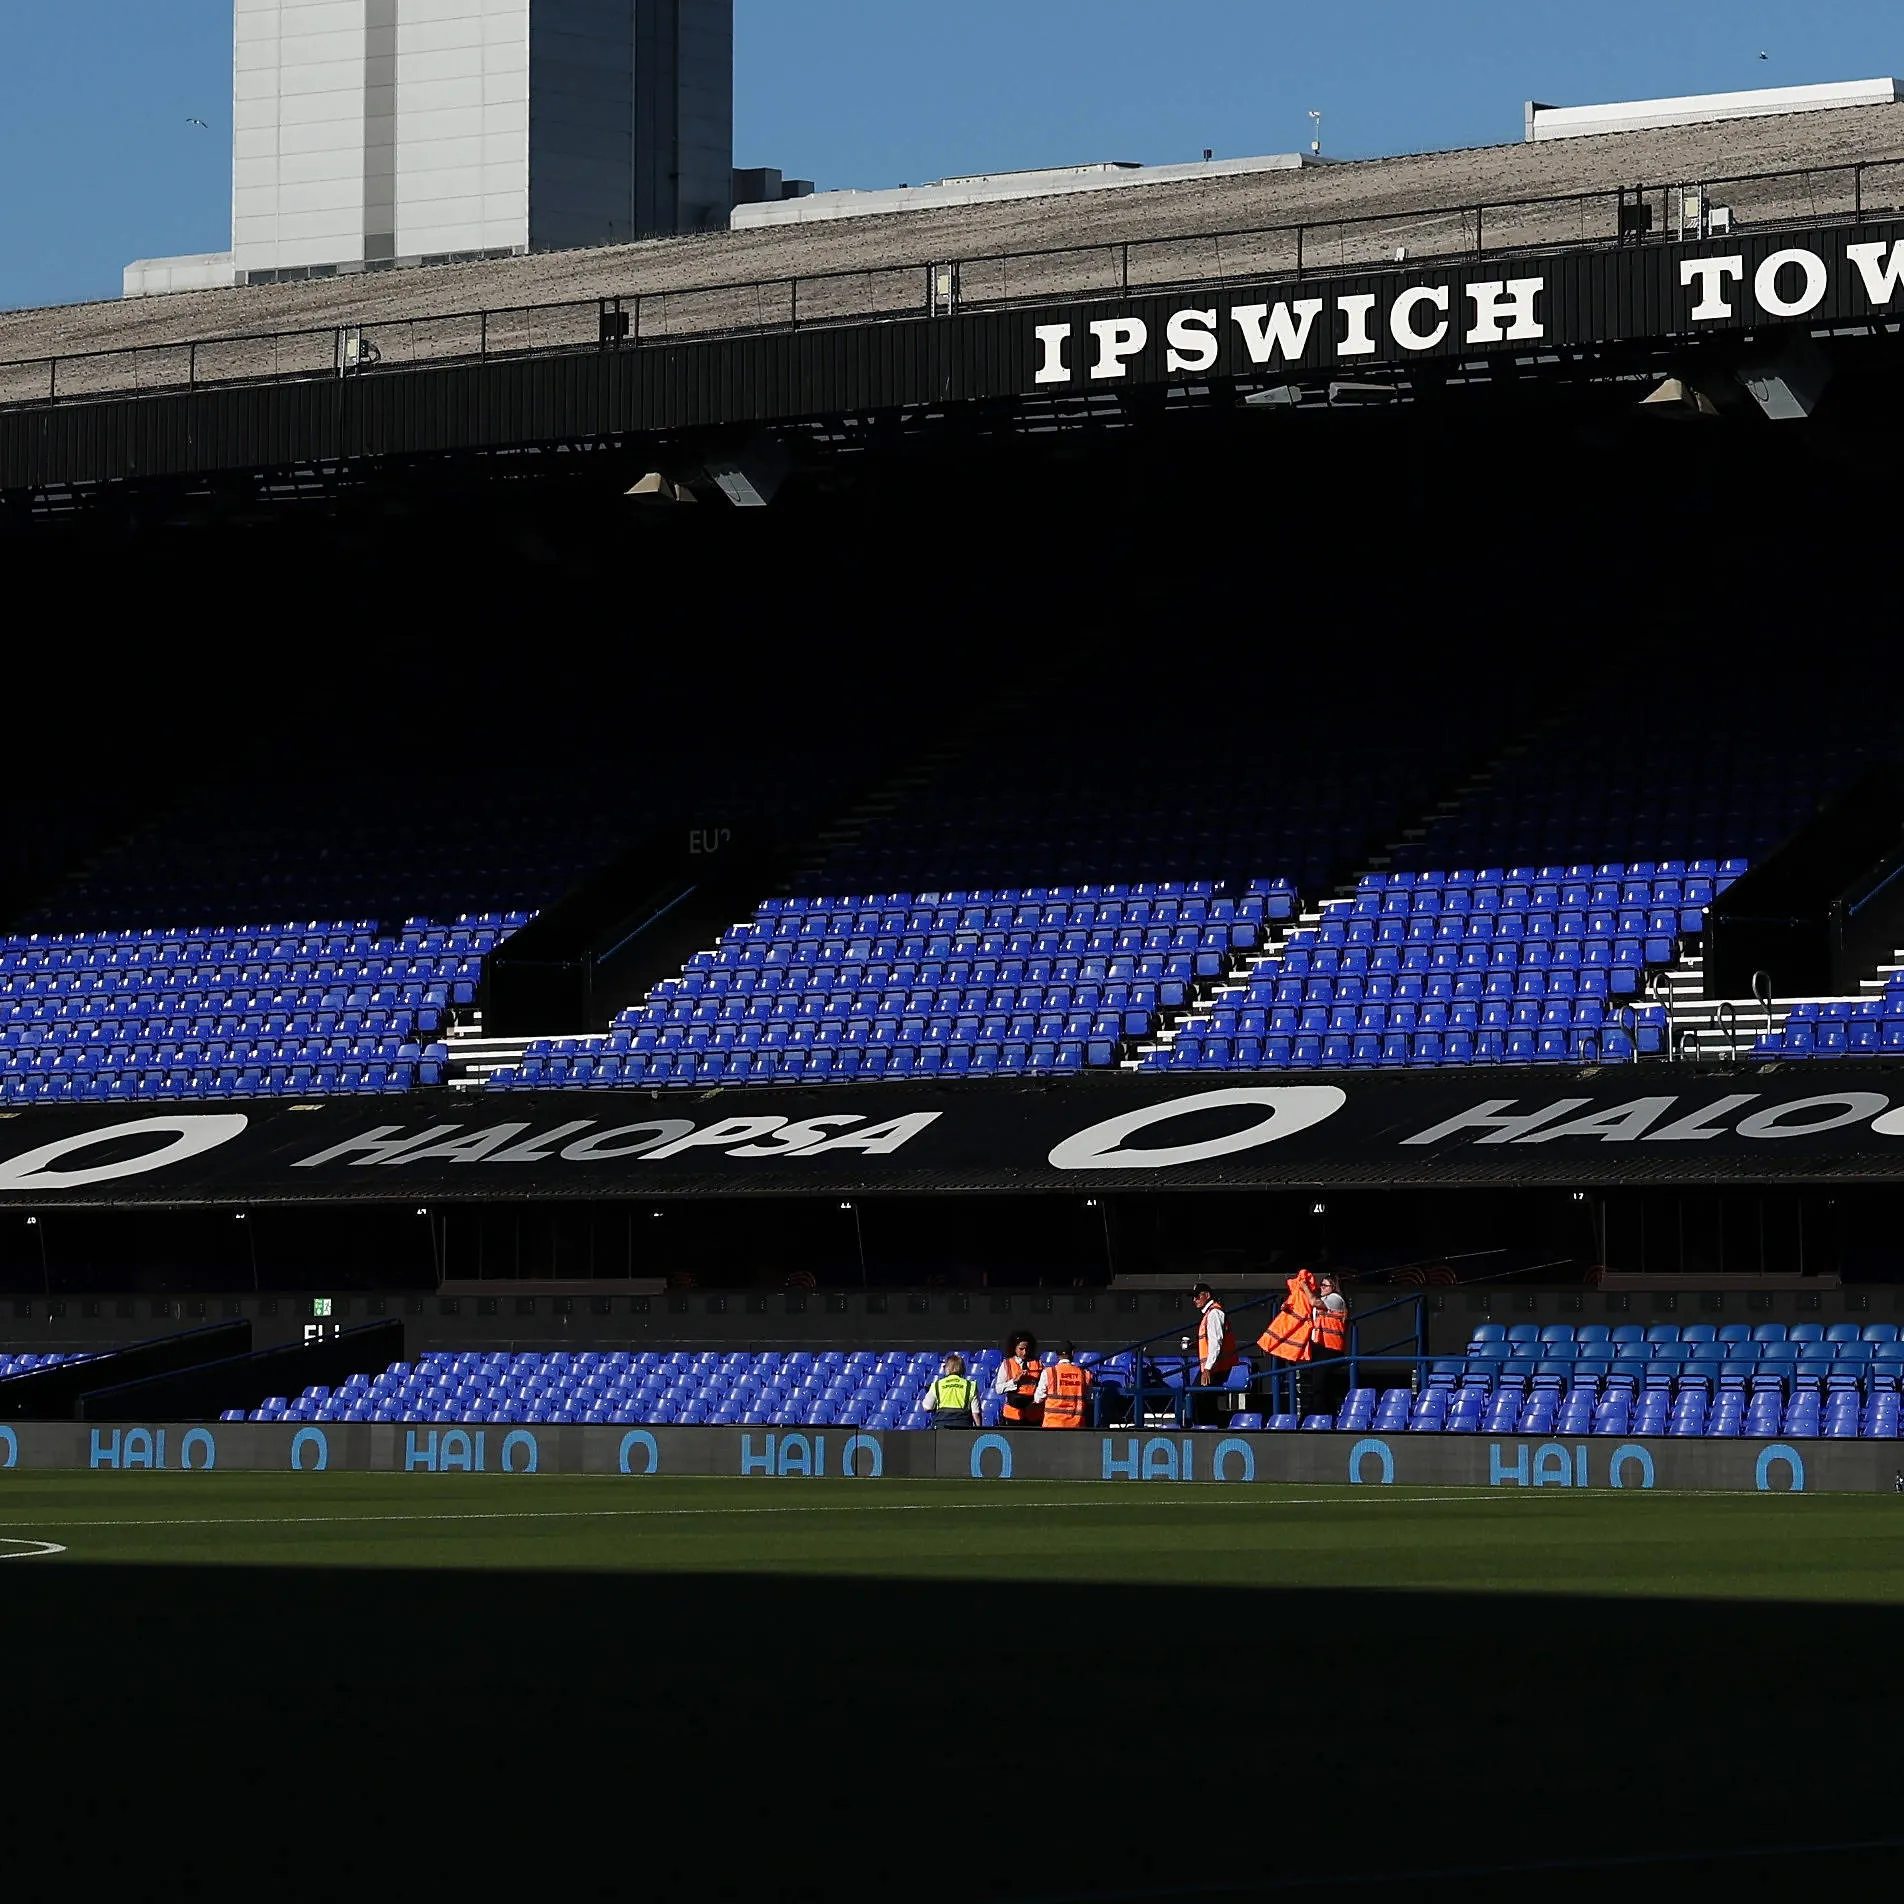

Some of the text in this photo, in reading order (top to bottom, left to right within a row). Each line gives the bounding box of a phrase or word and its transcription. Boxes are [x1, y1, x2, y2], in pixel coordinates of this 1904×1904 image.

[1033, 276, 1545, 386] IPSWICH
[289, 1111, 944, 1167] HALOPSA
[90, 1427, 216, 1469] HALO
[405, 1429, 539, 1473] HALO
[741, 1432, 883, 1478] HALO
[1102, 1437, 1255, 1482] HALO
[1490, 1443, 1655, 1489] HALO
